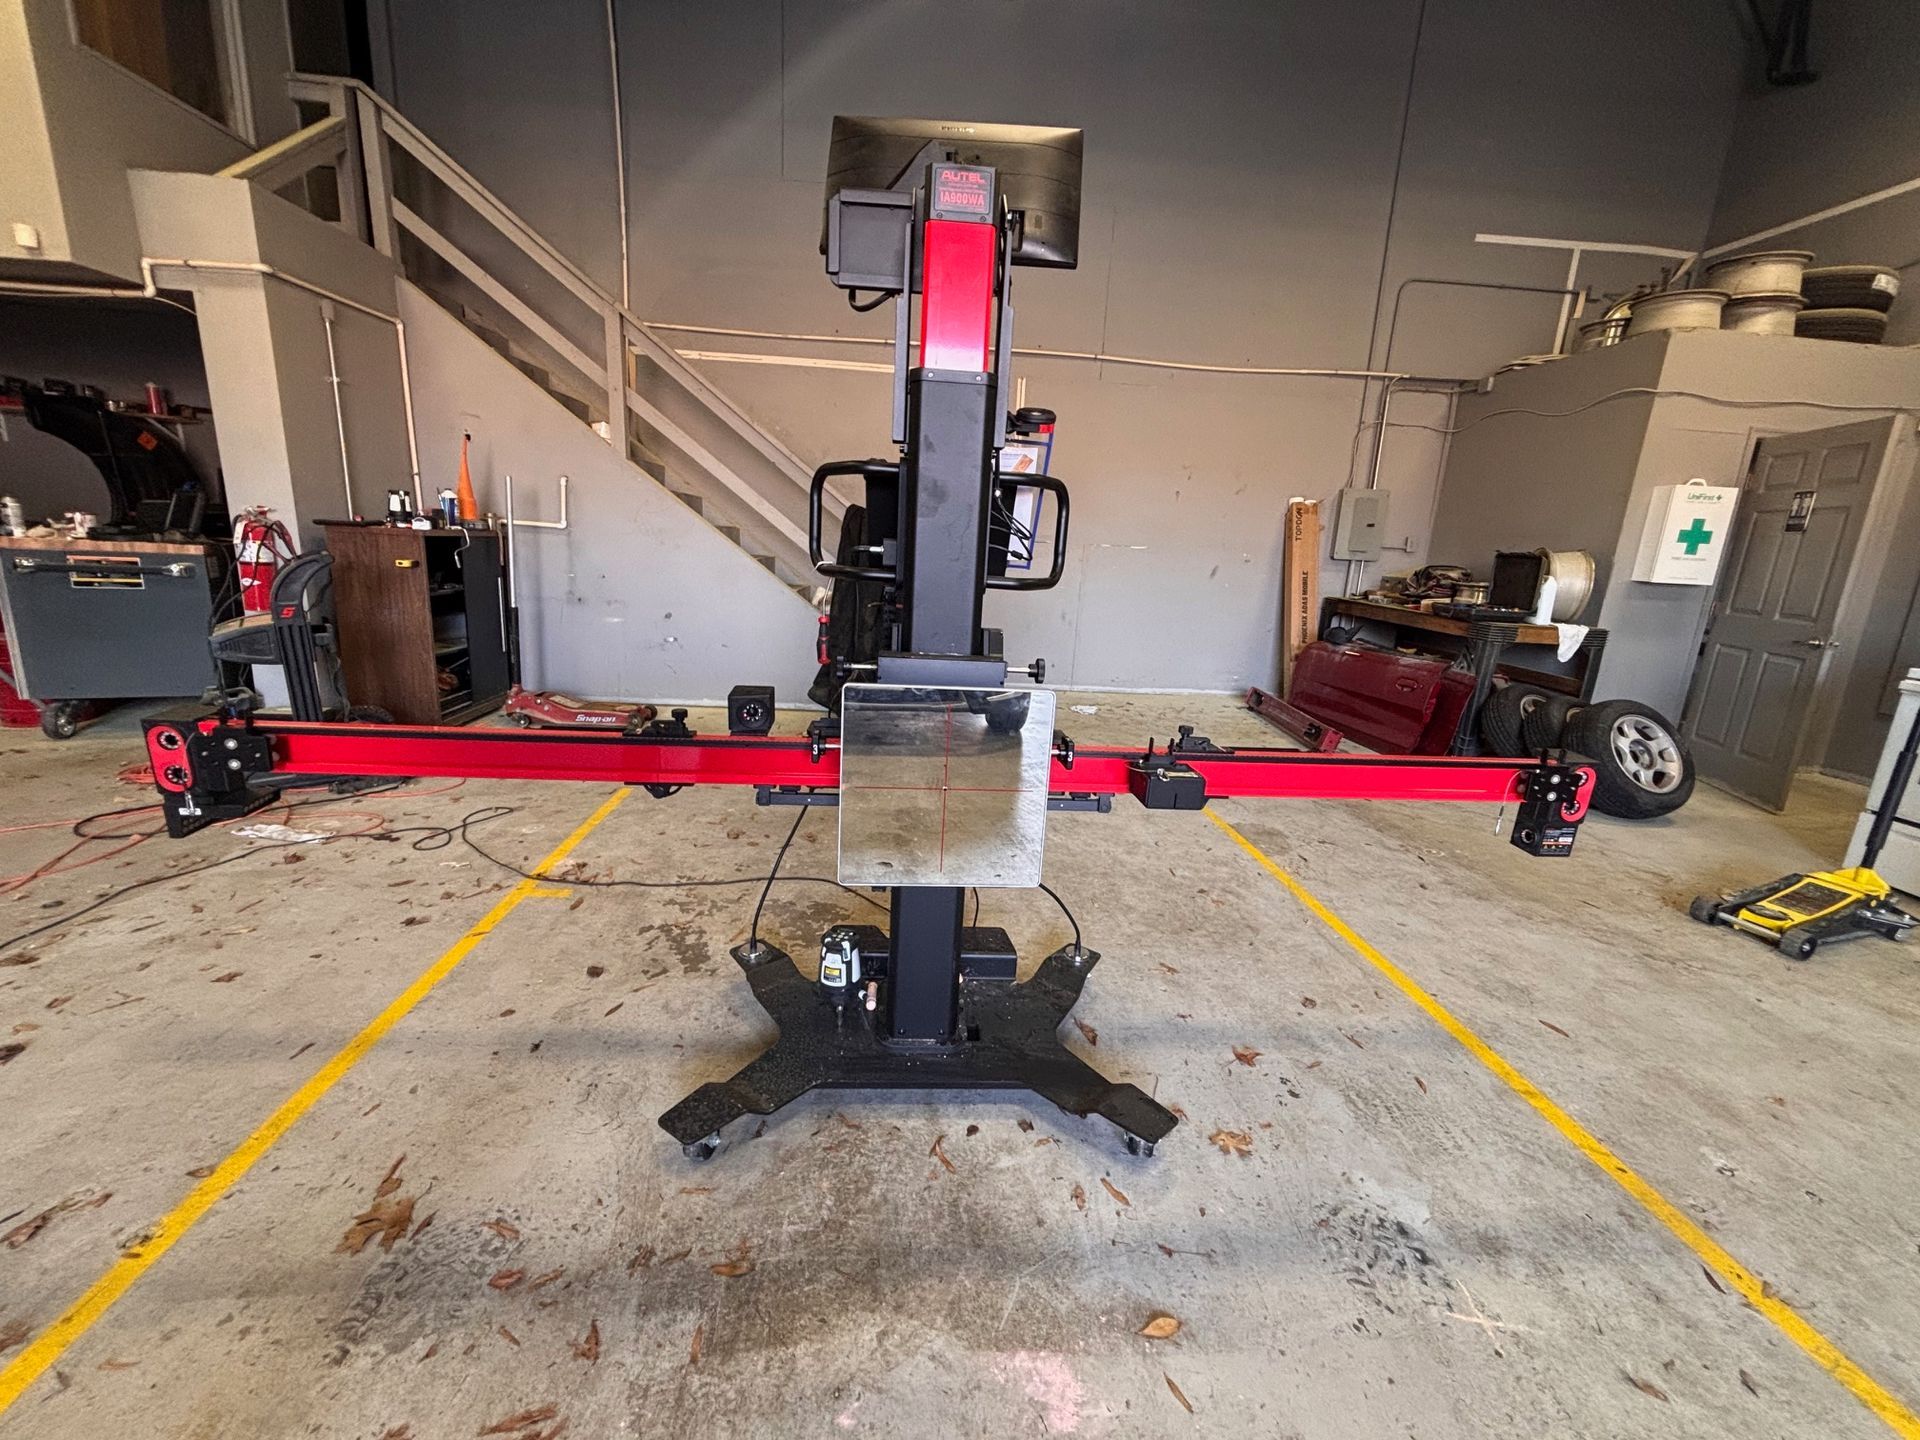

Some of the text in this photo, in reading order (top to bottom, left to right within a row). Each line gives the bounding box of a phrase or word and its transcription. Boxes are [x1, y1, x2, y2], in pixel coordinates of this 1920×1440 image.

[941, 170, 985, 184] AUTEL
[1295, 507, 1303, 542] TOPDON
[575, 714, 616, 724] Snap-on
[812, 744, 819, 755] 3
[1067, 751, 1074, 762] 3
